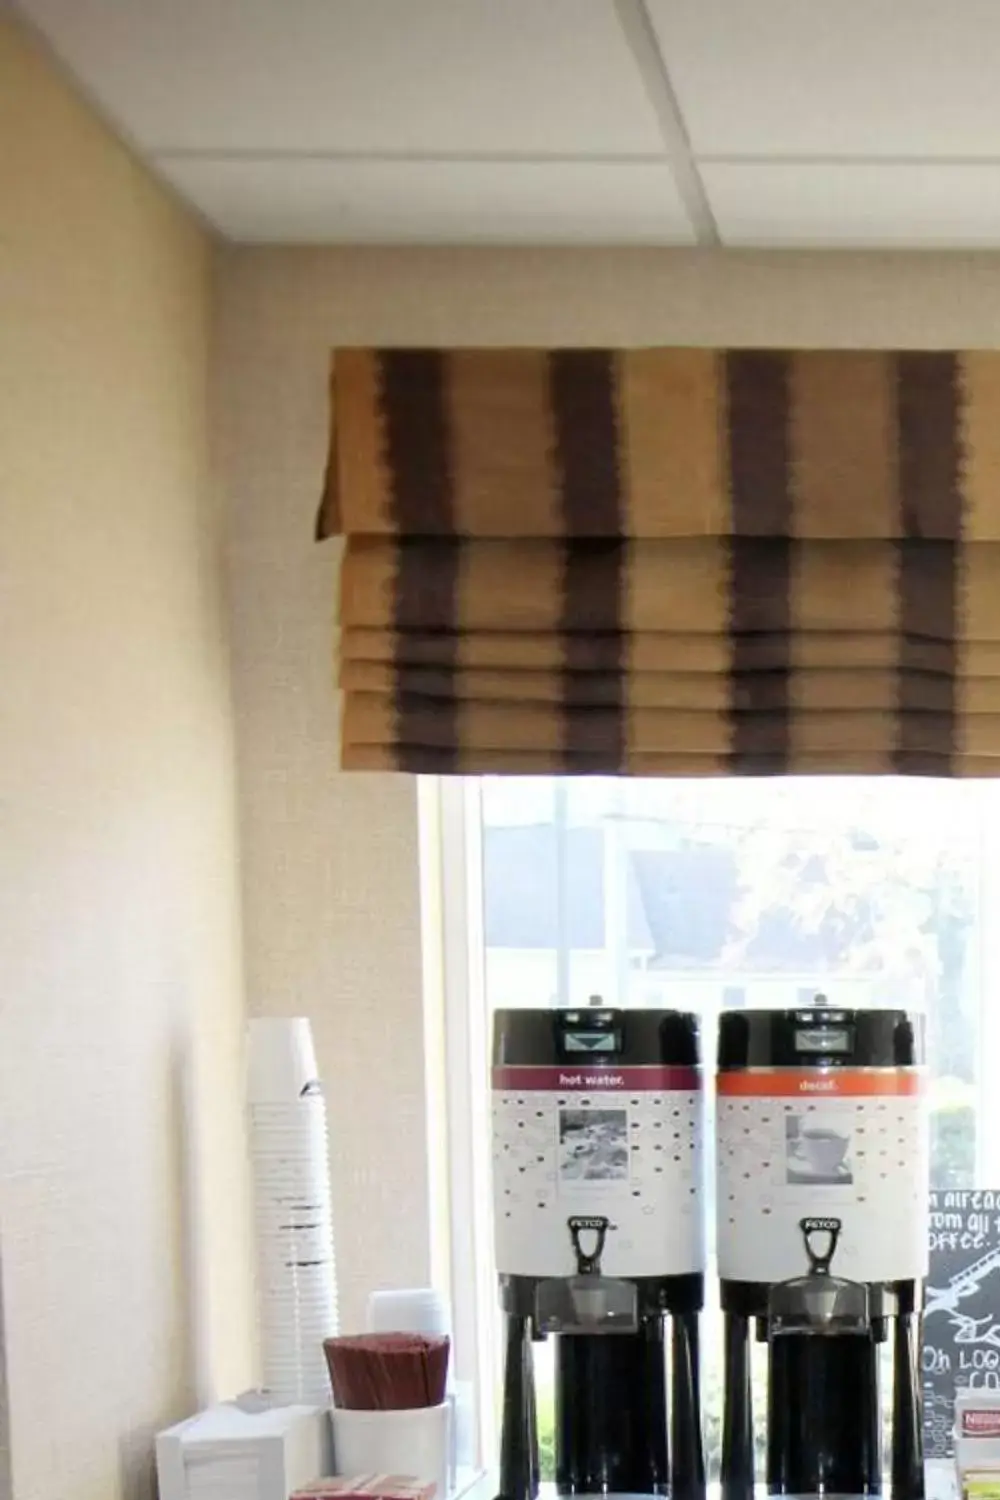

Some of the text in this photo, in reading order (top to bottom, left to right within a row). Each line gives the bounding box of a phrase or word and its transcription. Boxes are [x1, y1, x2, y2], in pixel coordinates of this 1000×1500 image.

[559, 1073, 624, 1087] hot water.
[922, 1345, 950, 1371] Oh
